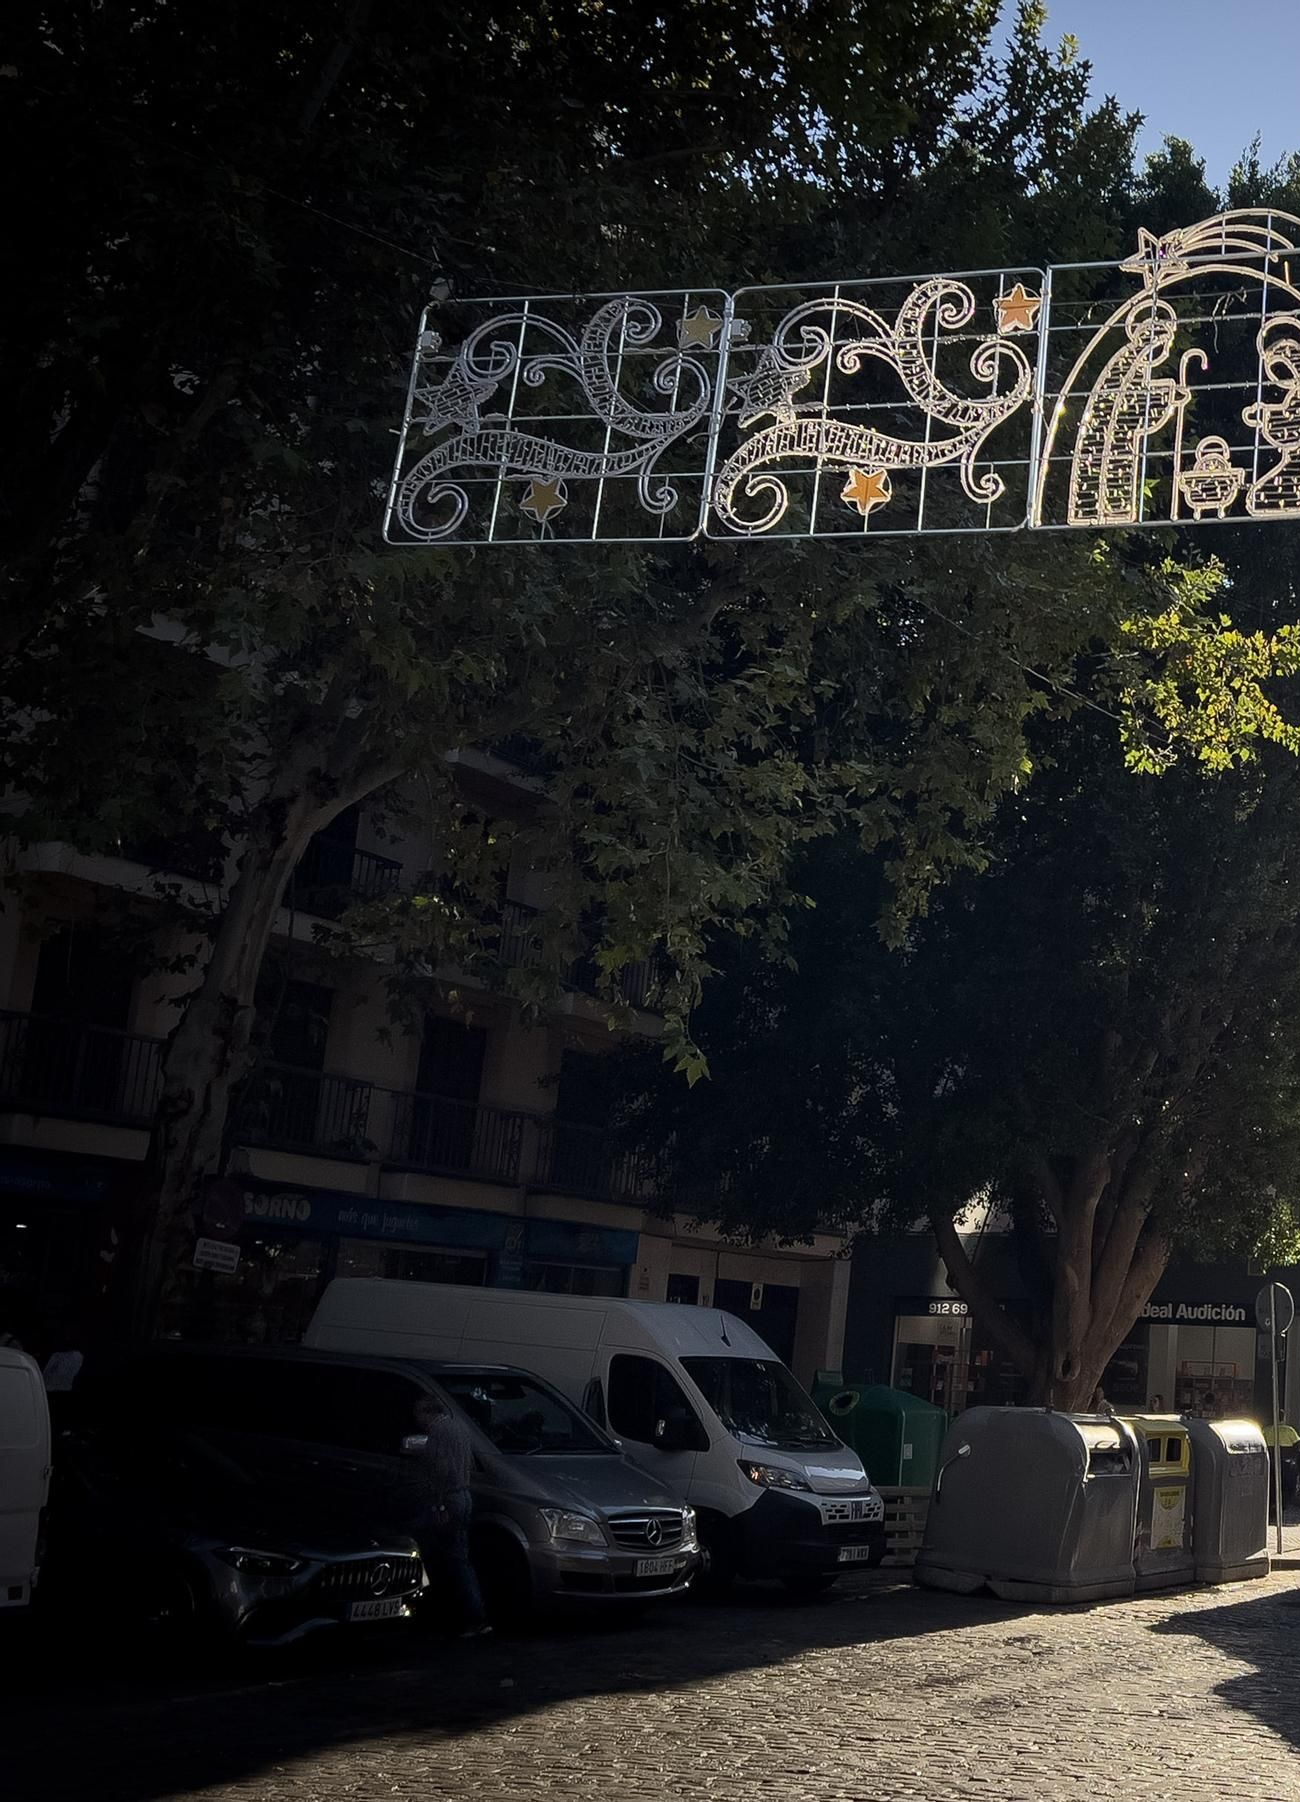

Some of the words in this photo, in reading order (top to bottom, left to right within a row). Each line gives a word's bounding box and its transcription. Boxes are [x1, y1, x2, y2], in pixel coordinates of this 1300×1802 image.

[928, 1303, 950, 1315] 912
[951, 1303, 969, 1315] 69
[1140, 1301, 1173, 1319] deal
[1175, 1303, 1247, 1321] Audición
